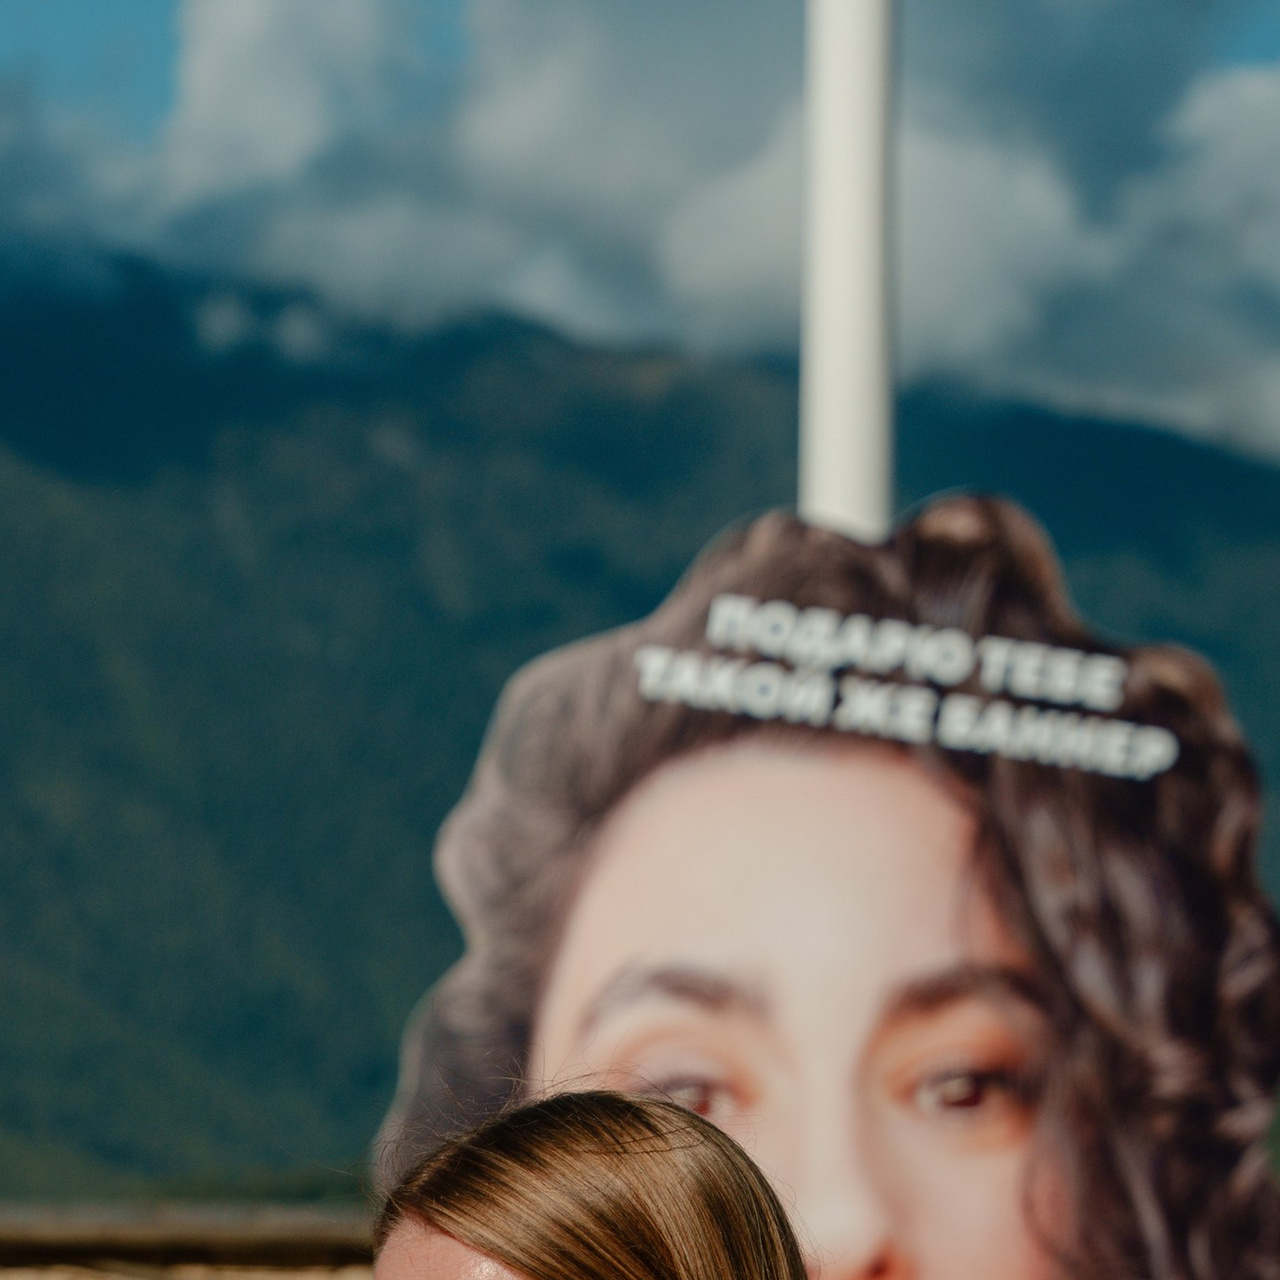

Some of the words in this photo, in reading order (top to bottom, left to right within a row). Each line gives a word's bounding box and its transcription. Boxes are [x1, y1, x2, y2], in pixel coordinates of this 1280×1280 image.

[635, 644, 835, 728] ТАКОЙ
[835, 677, 938, 745] ЖЕ
[937, 695, 1180, 781] БАННЕР
[708, 594, 975, 686] ПОДАРЮ
[981, 635, 1127, 712] ТЕБЕ
